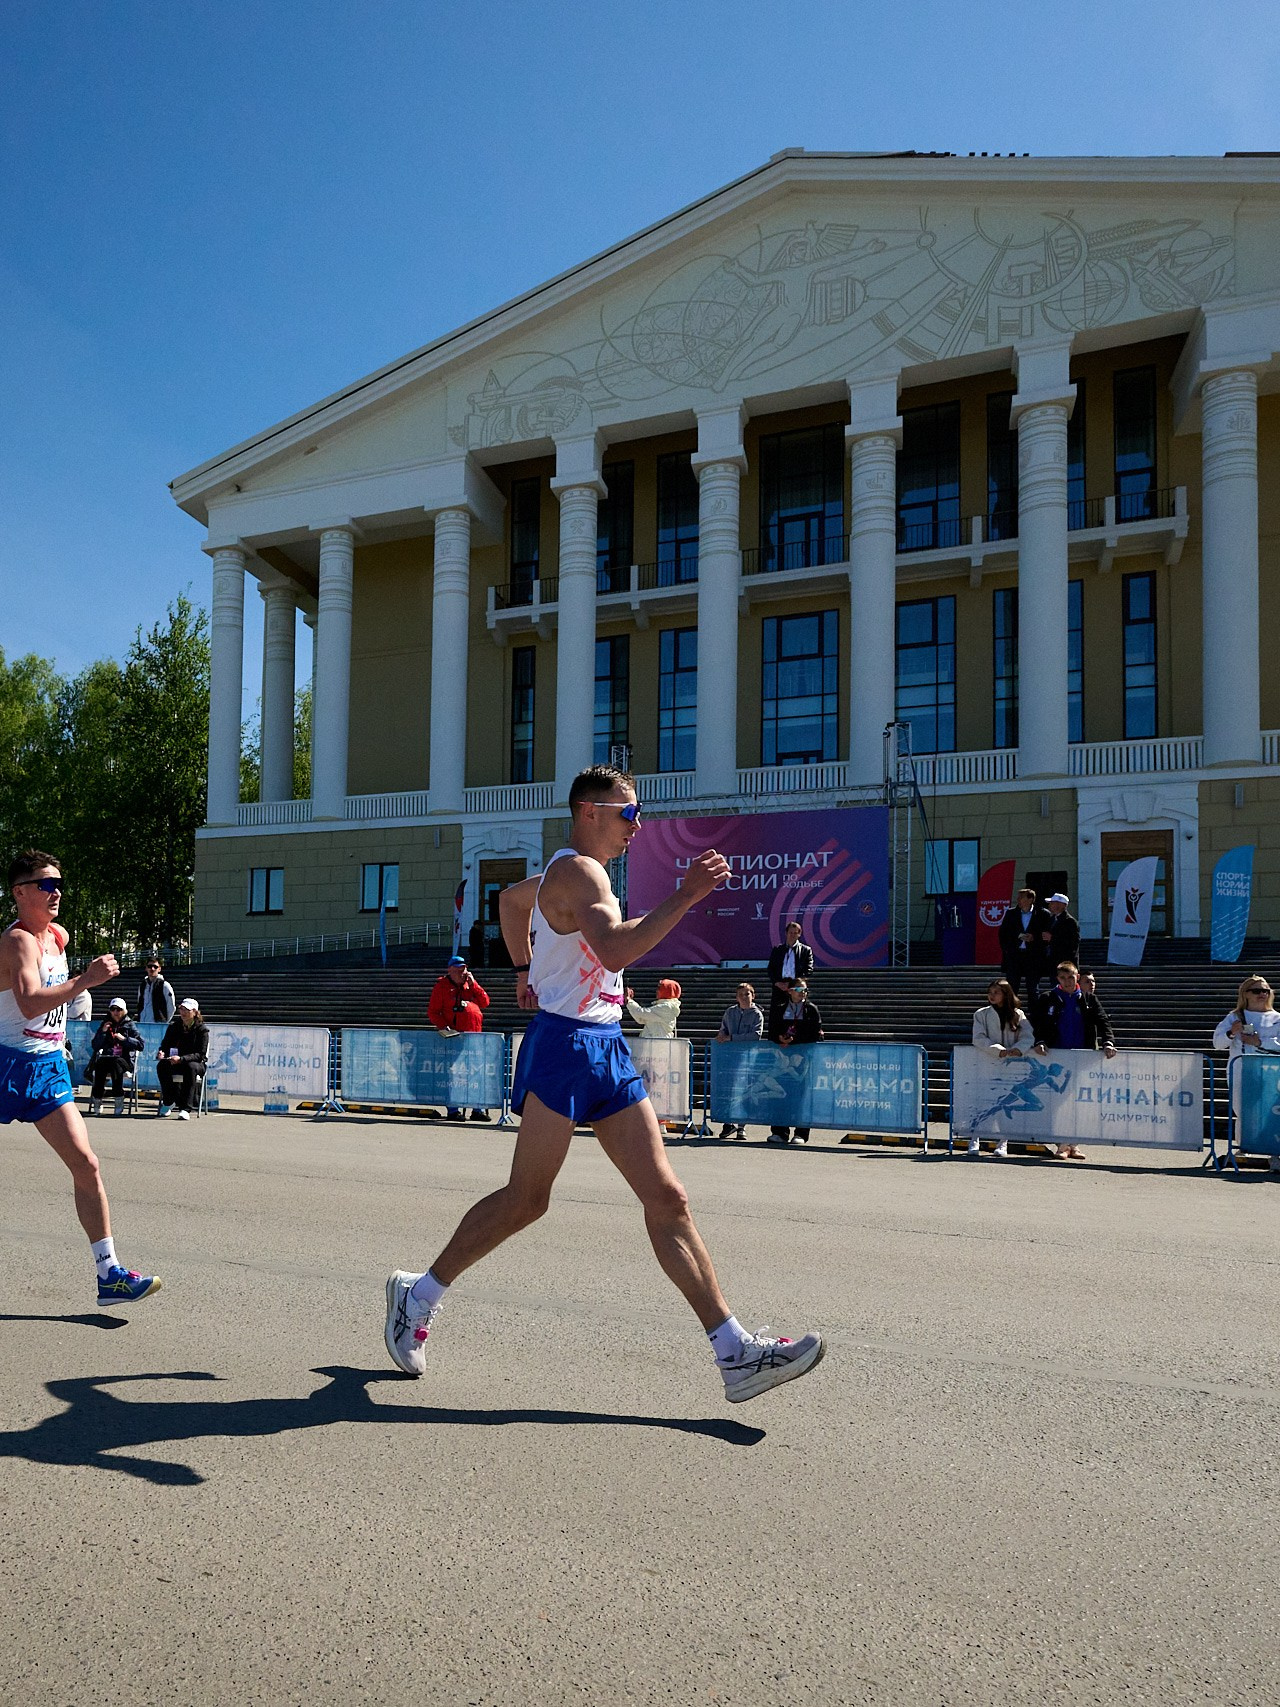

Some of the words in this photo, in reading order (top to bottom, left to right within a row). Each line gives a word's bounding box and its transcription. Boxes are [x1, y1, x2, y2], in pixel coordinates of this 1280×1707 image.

[675, 851, 834, 871] ЧПИОНАТ
[675, 873, 777, 892] СИИ
[783, 880, 824, 889] ХОДЬБЕ
[1216, 880, 1250, 889] НОРМА
[1216, 888, 1250, 898] ЖИЗНИ
[256, 1054, 322, 1069] ДИНАМО
[825, 1061, 901, 1071] DYNAMO-UDM.RU
[641, 1069, 681, 1084] АМО
[1089, 1071, 1178, 1082] DYNAMO-UDM.RU
[815, 1075, 914, 1094] ДИНАМО
[1075, 1087, 1194, 1107] ДИНАМО
[835, 1099, 891, 1109] УДМУРТИЯ
[1100, 1112, 1167, 1124] УДМУРТИЯ
